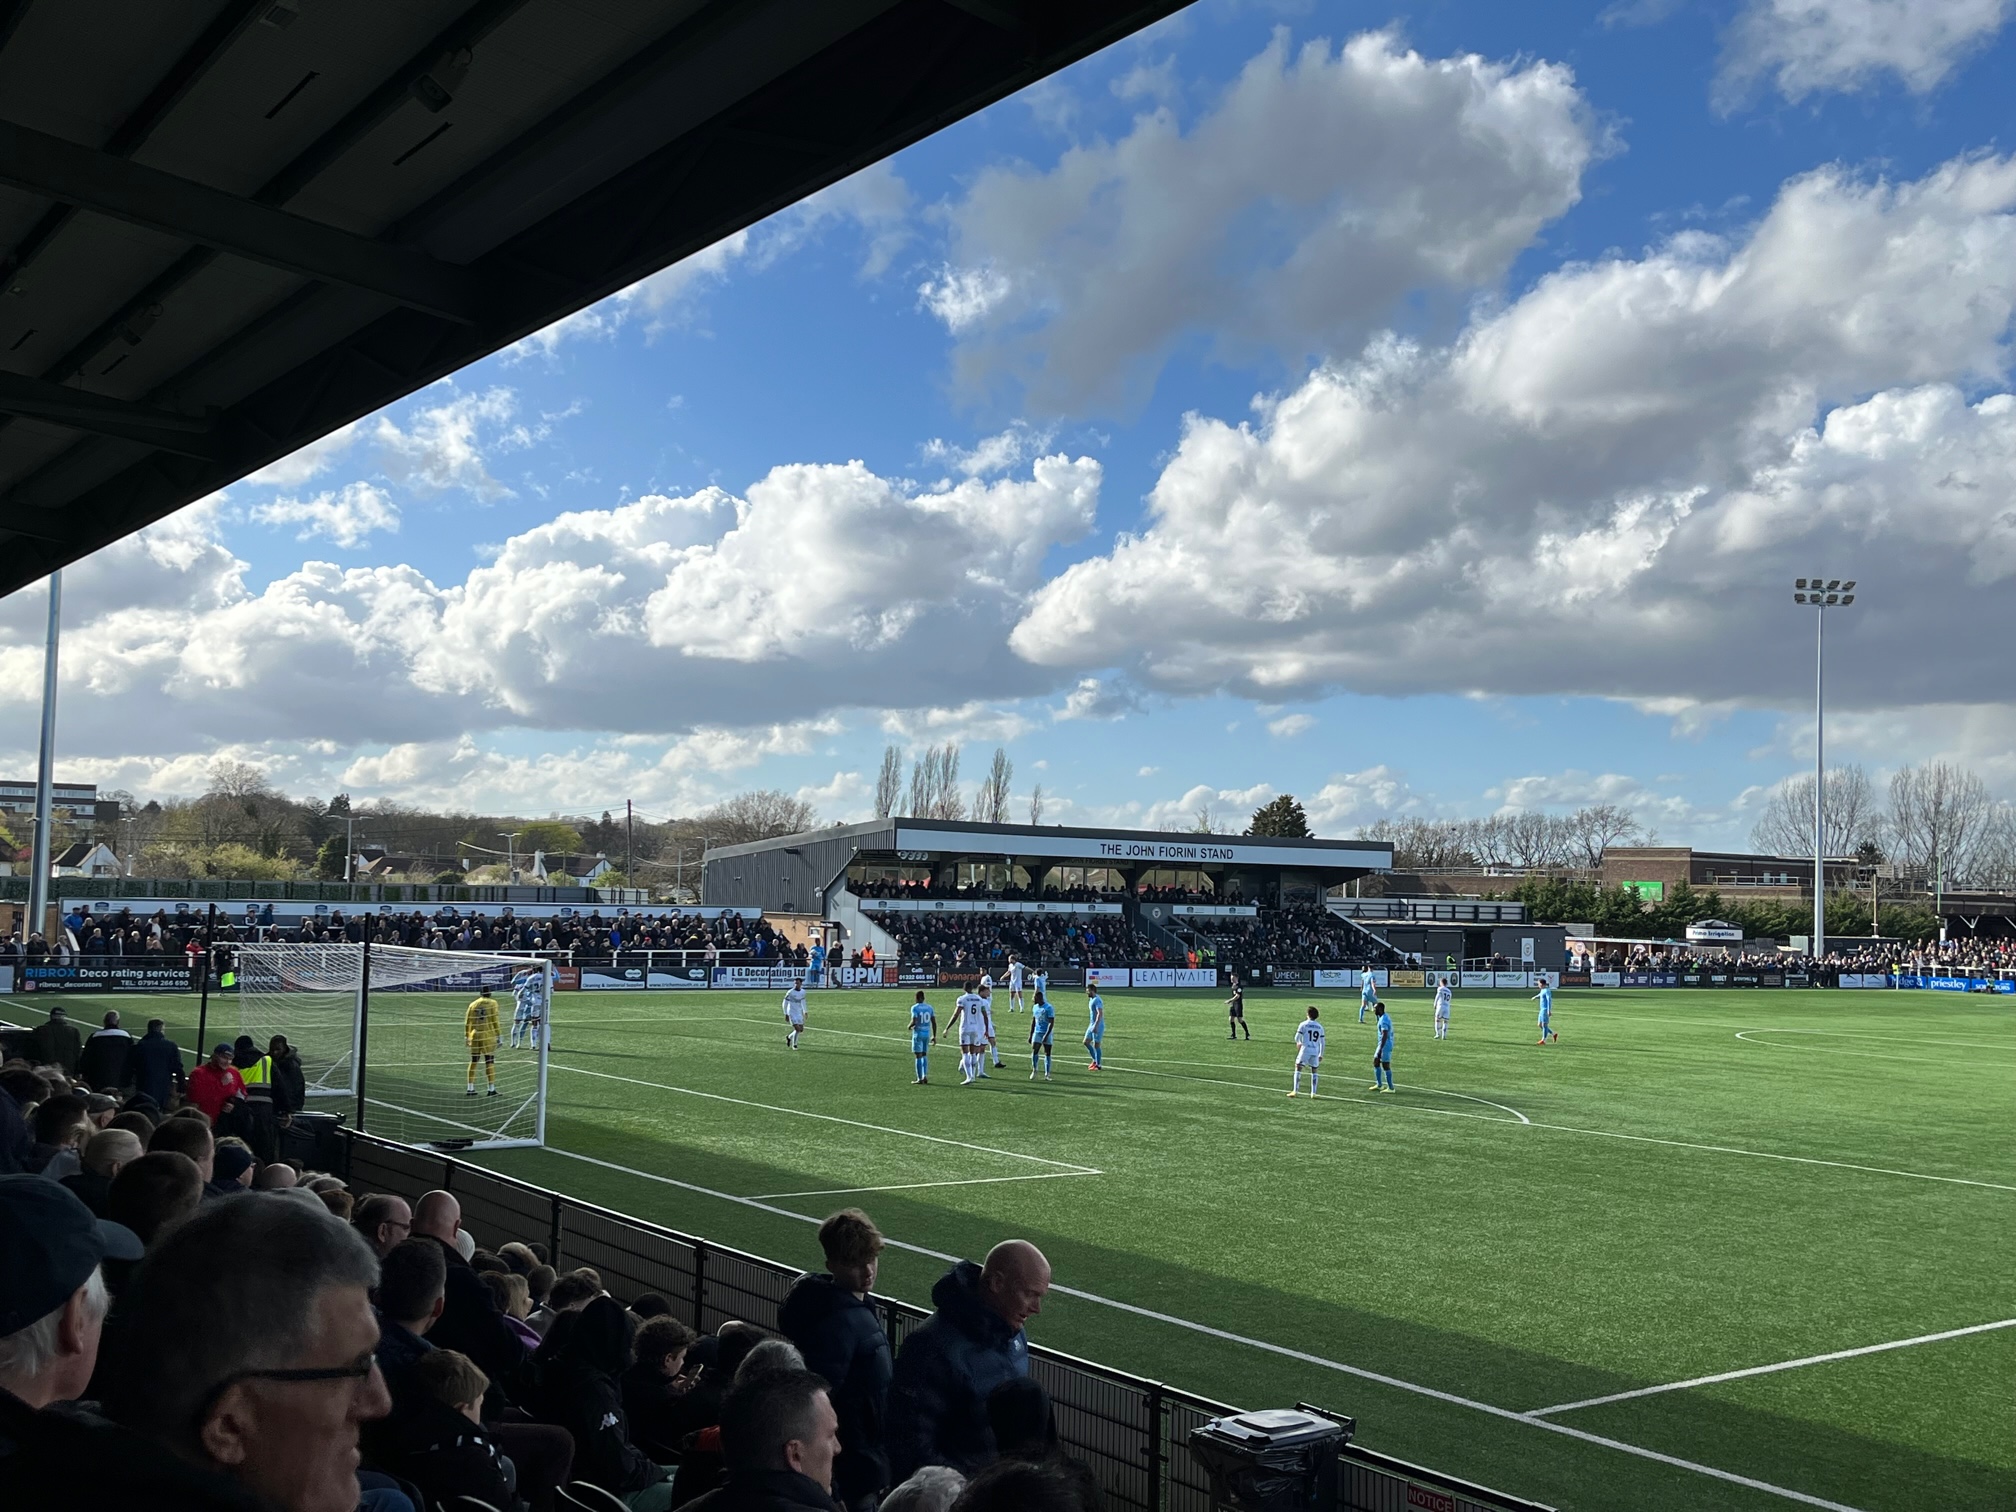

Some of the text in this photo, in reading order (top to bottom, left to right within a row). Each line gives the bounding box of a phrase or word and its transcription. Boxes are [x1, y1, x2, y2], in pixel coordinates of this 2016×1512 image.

[1100, 844, 1234, 860] THE JOHN FIORINI STAND
[25, 968, 76, 977] RIBROX
[146, 968, 190, 978] services
[737, 968, 743, 976] G
[794, 968, 805, 977] Ltd
[842, 967, 882, 983] BPM
[949, 973, 982, 981] vanaram
[1135, 971, 1214, 982] LEATHWAITE
[1274, 971, 1300, 980] UMECH
[232, 974, 279, 984] NSURANCE
[39, 981, 102, 989] ribrox_decorators
[1930, 979, 1967, 991] priestley
[971, 1003, 977, 1014] 6
[920, 1012, 931, 1024] 10
[1307, 1030, 1320, 1042] 19
[1408, 1489, 1453, 1512] NOTICE
